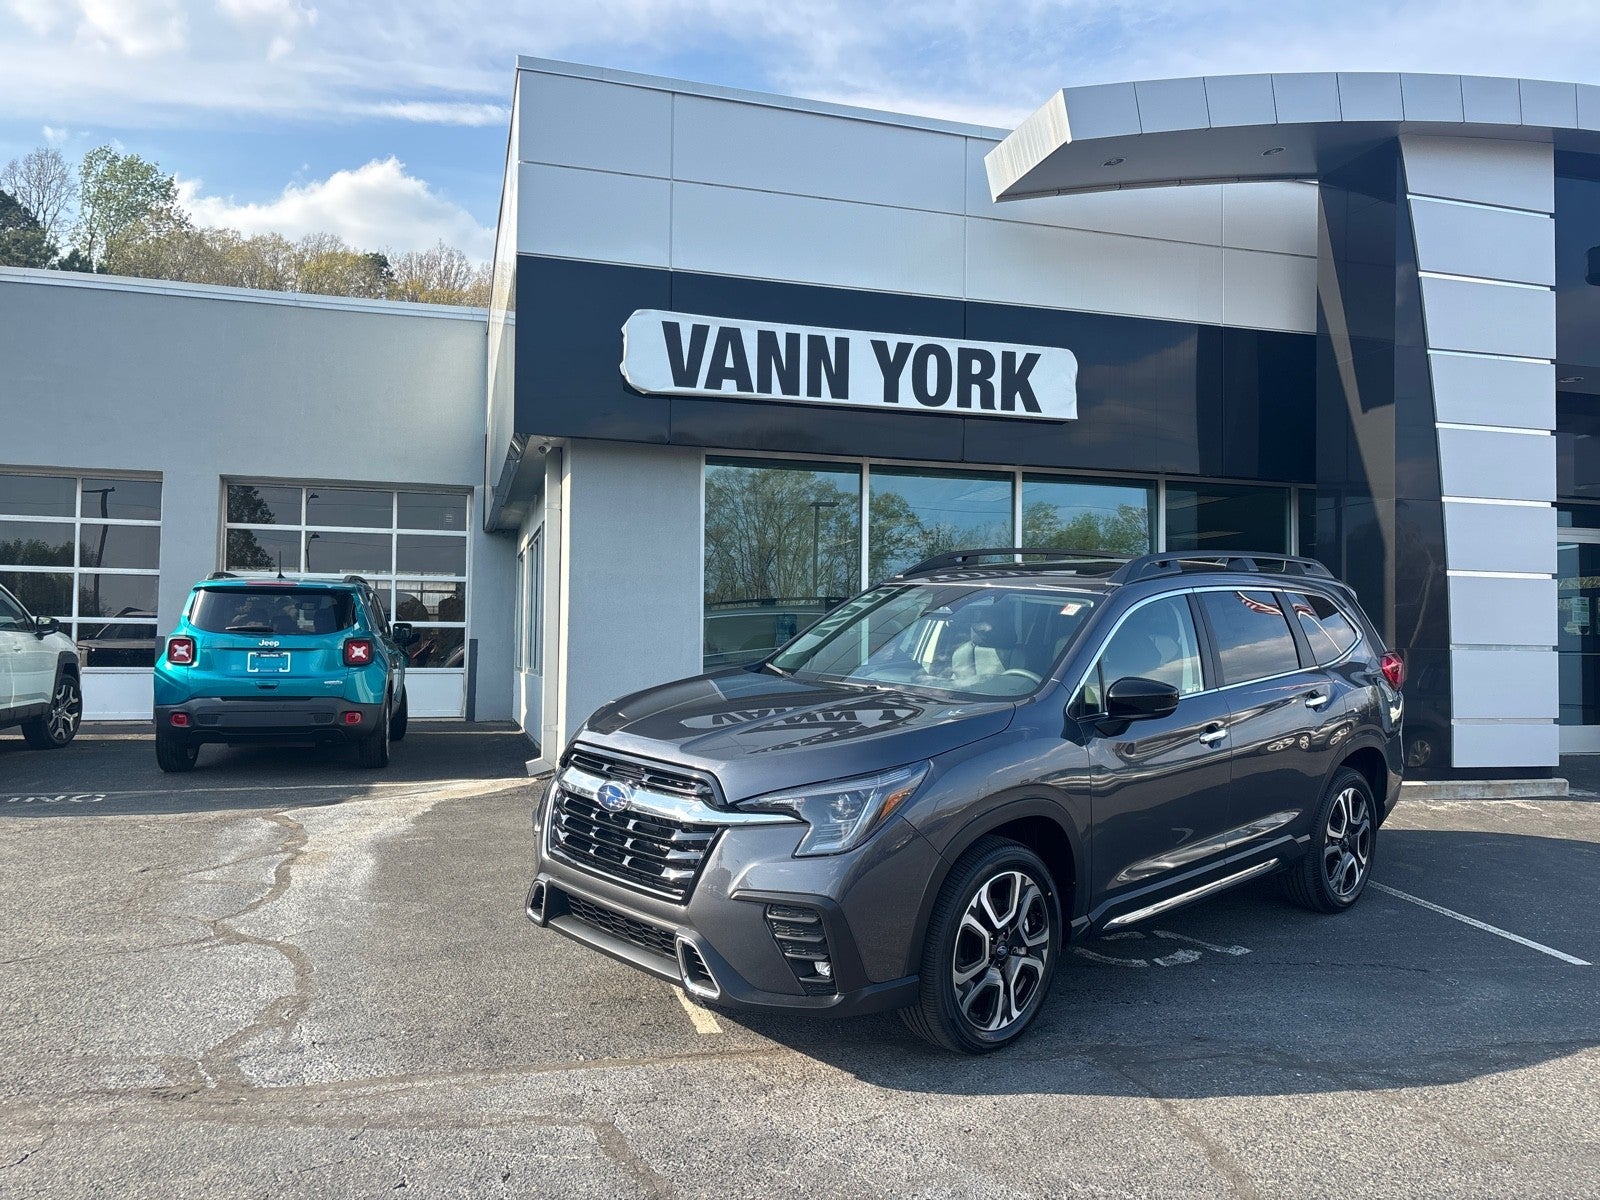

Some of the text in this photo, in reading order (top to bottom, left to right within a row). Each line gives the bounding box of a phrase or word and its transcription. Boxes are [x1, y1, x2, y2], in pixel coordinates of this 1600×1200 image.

[661, 321, 1042, 413] VANN YORK
[259, 640, 280, 648] Jeep
